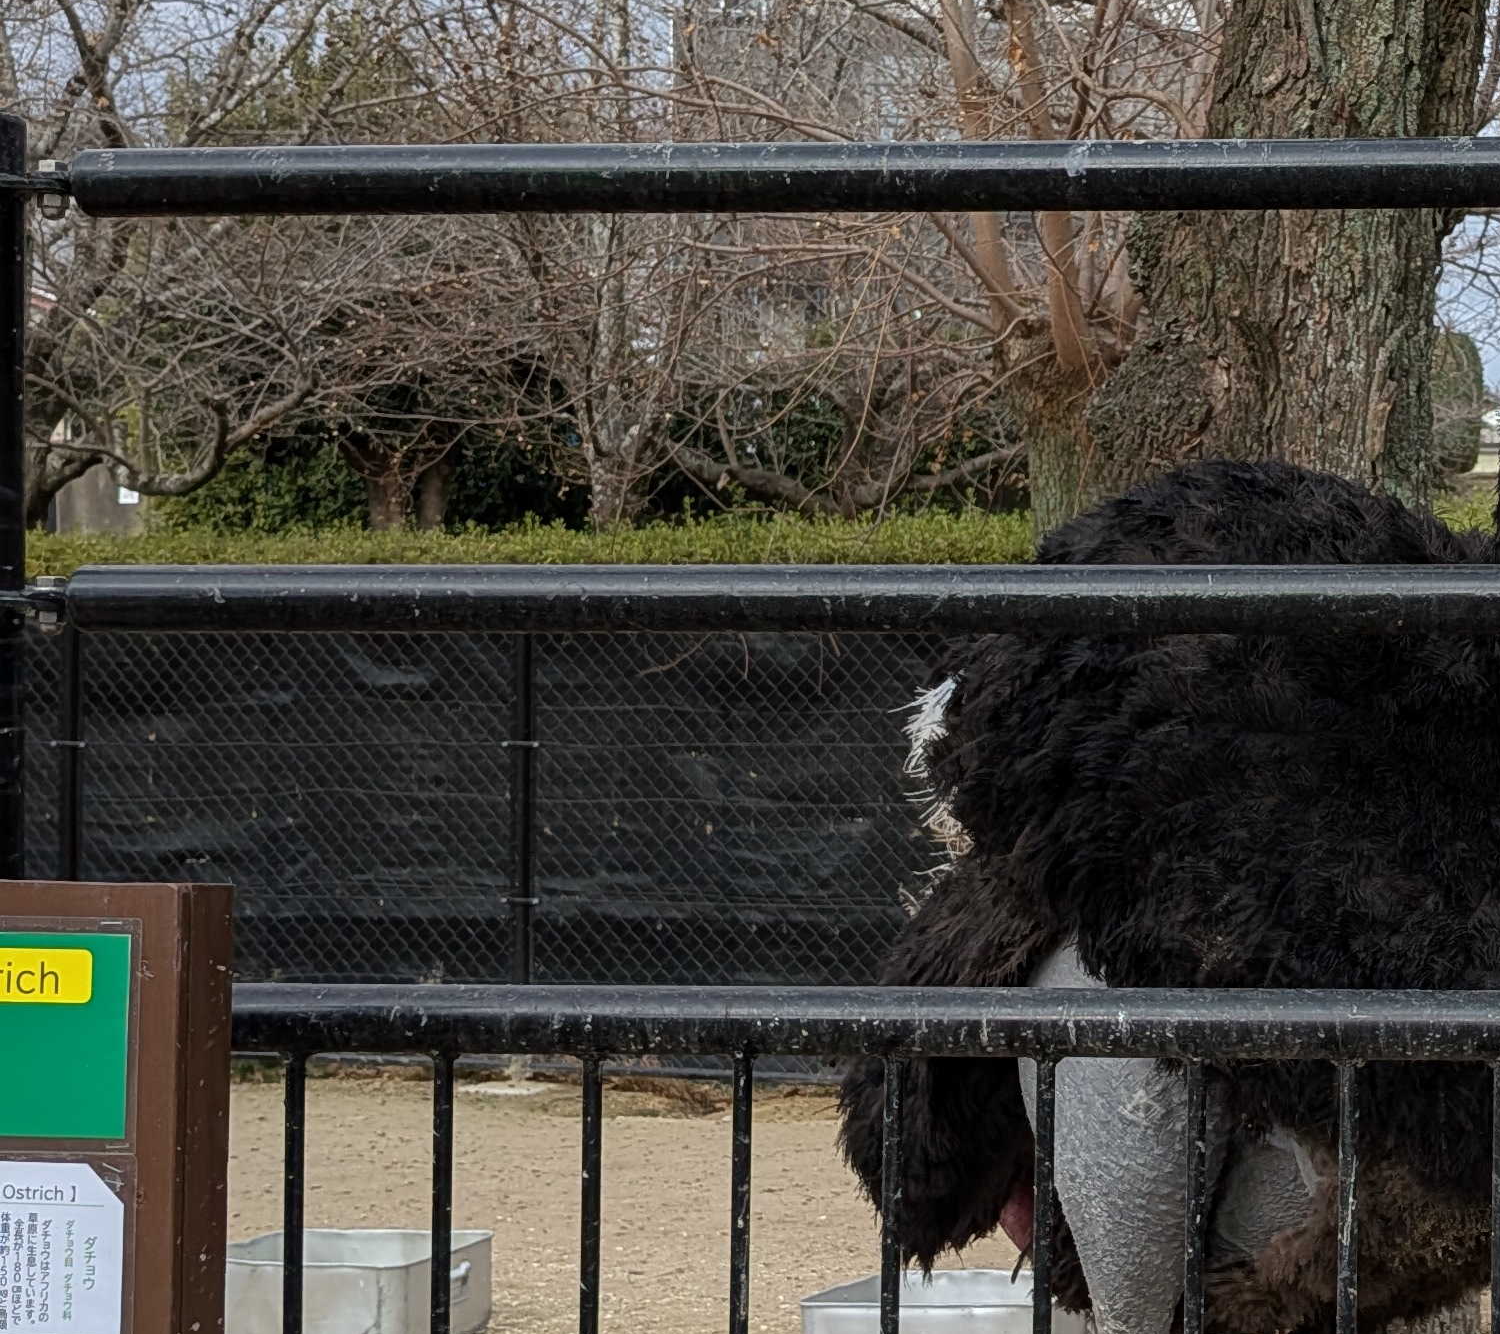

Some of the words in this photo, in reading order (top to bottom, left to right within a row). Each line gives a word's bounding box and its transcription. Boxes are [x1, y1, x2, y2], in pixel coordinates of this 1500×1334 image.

[0, 961, 58, 994] ich
[3, 1185, 64, 1201] Ostrich
[65, 1220, 75, 1267] ダチョウ目
[83, 1236, 98, 1290] ダチョウ
[26, 1212, 38, 1325] 草原に生息しています。
[38, 1219, 52, 1322] ダチョウはアフリカの
[63, 1273, 74, 1321] ダチョウ科
